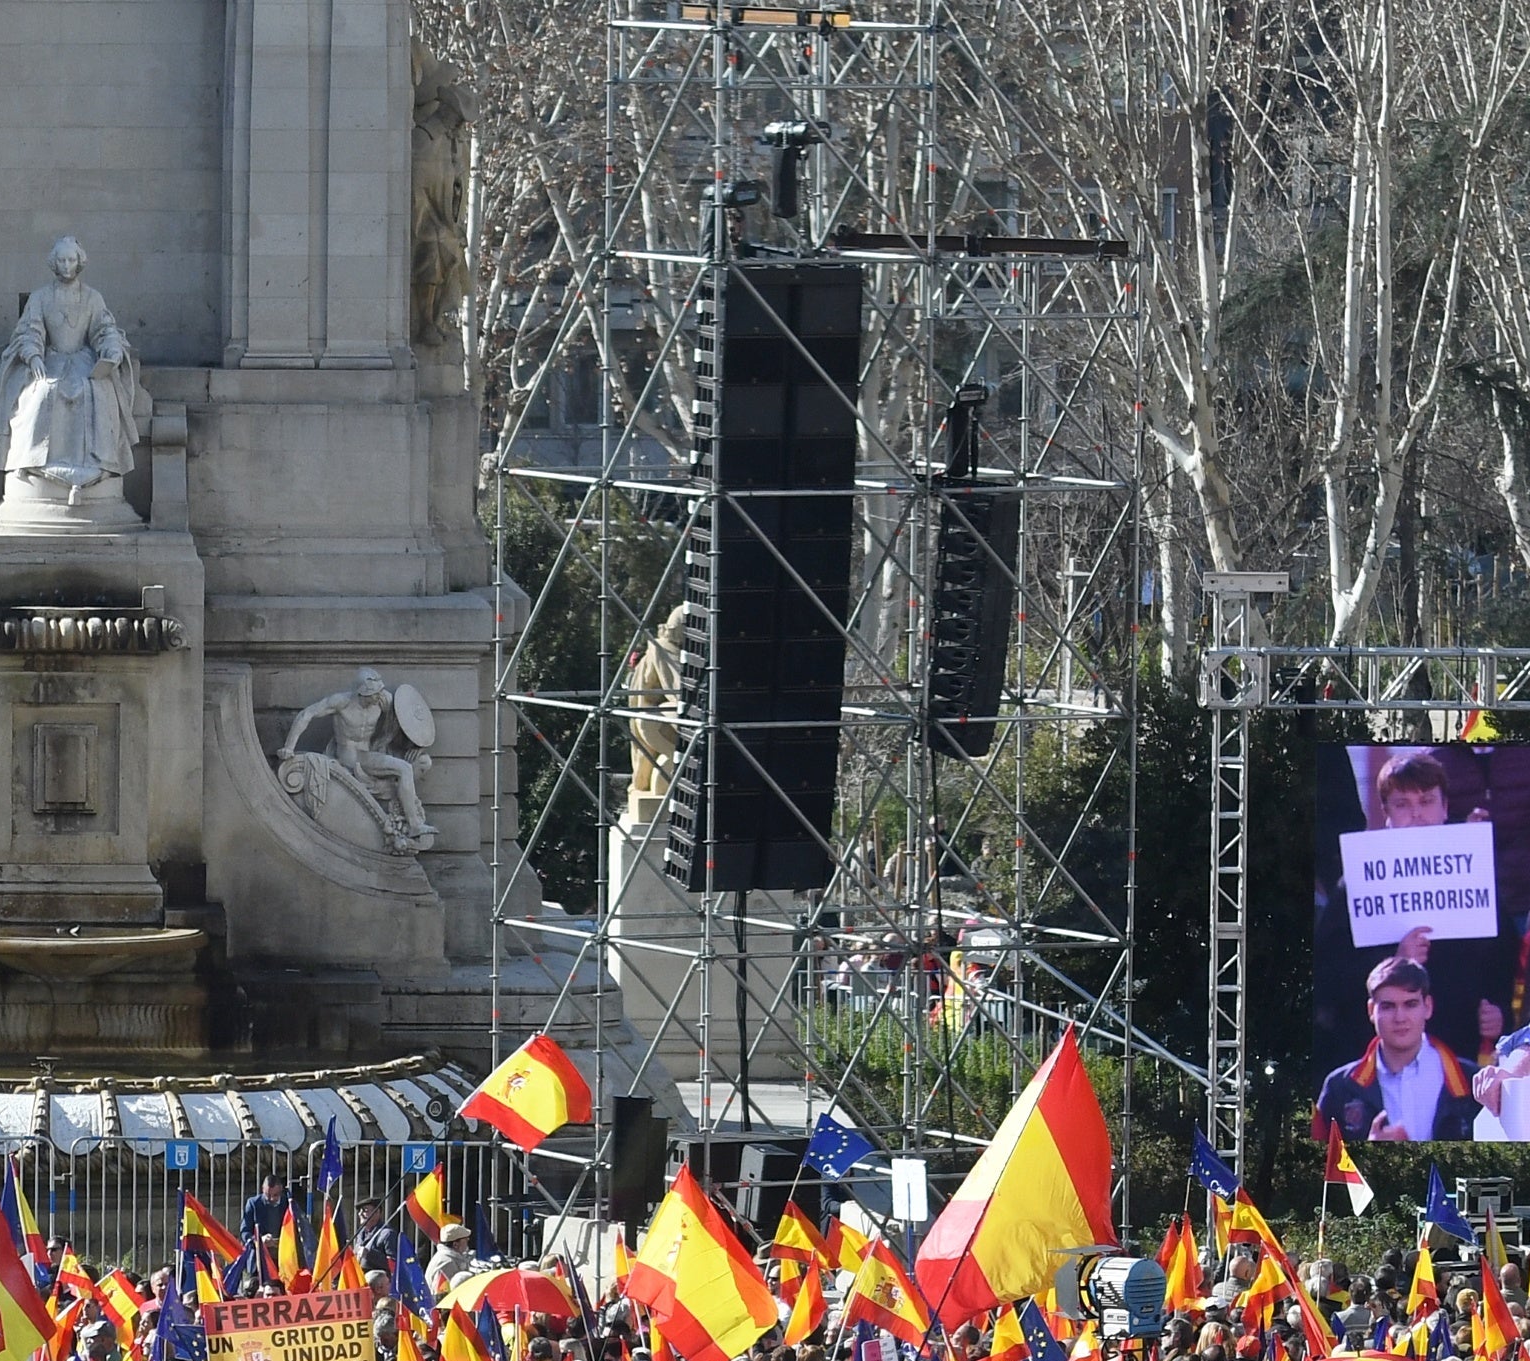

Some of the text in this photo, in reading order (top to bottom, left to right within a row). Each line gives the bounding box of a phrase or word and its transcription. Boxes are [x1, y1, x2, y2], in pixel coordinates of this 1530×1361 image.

[1364, 854, 1473, 881] NO AMNESTY
[1353, 888, 1489, 918] FOR TERRORISM
[214, 1293, 362, 1330] FERRAZ!!!
[208, 1322, 369, 1354] UN GRITO DE
